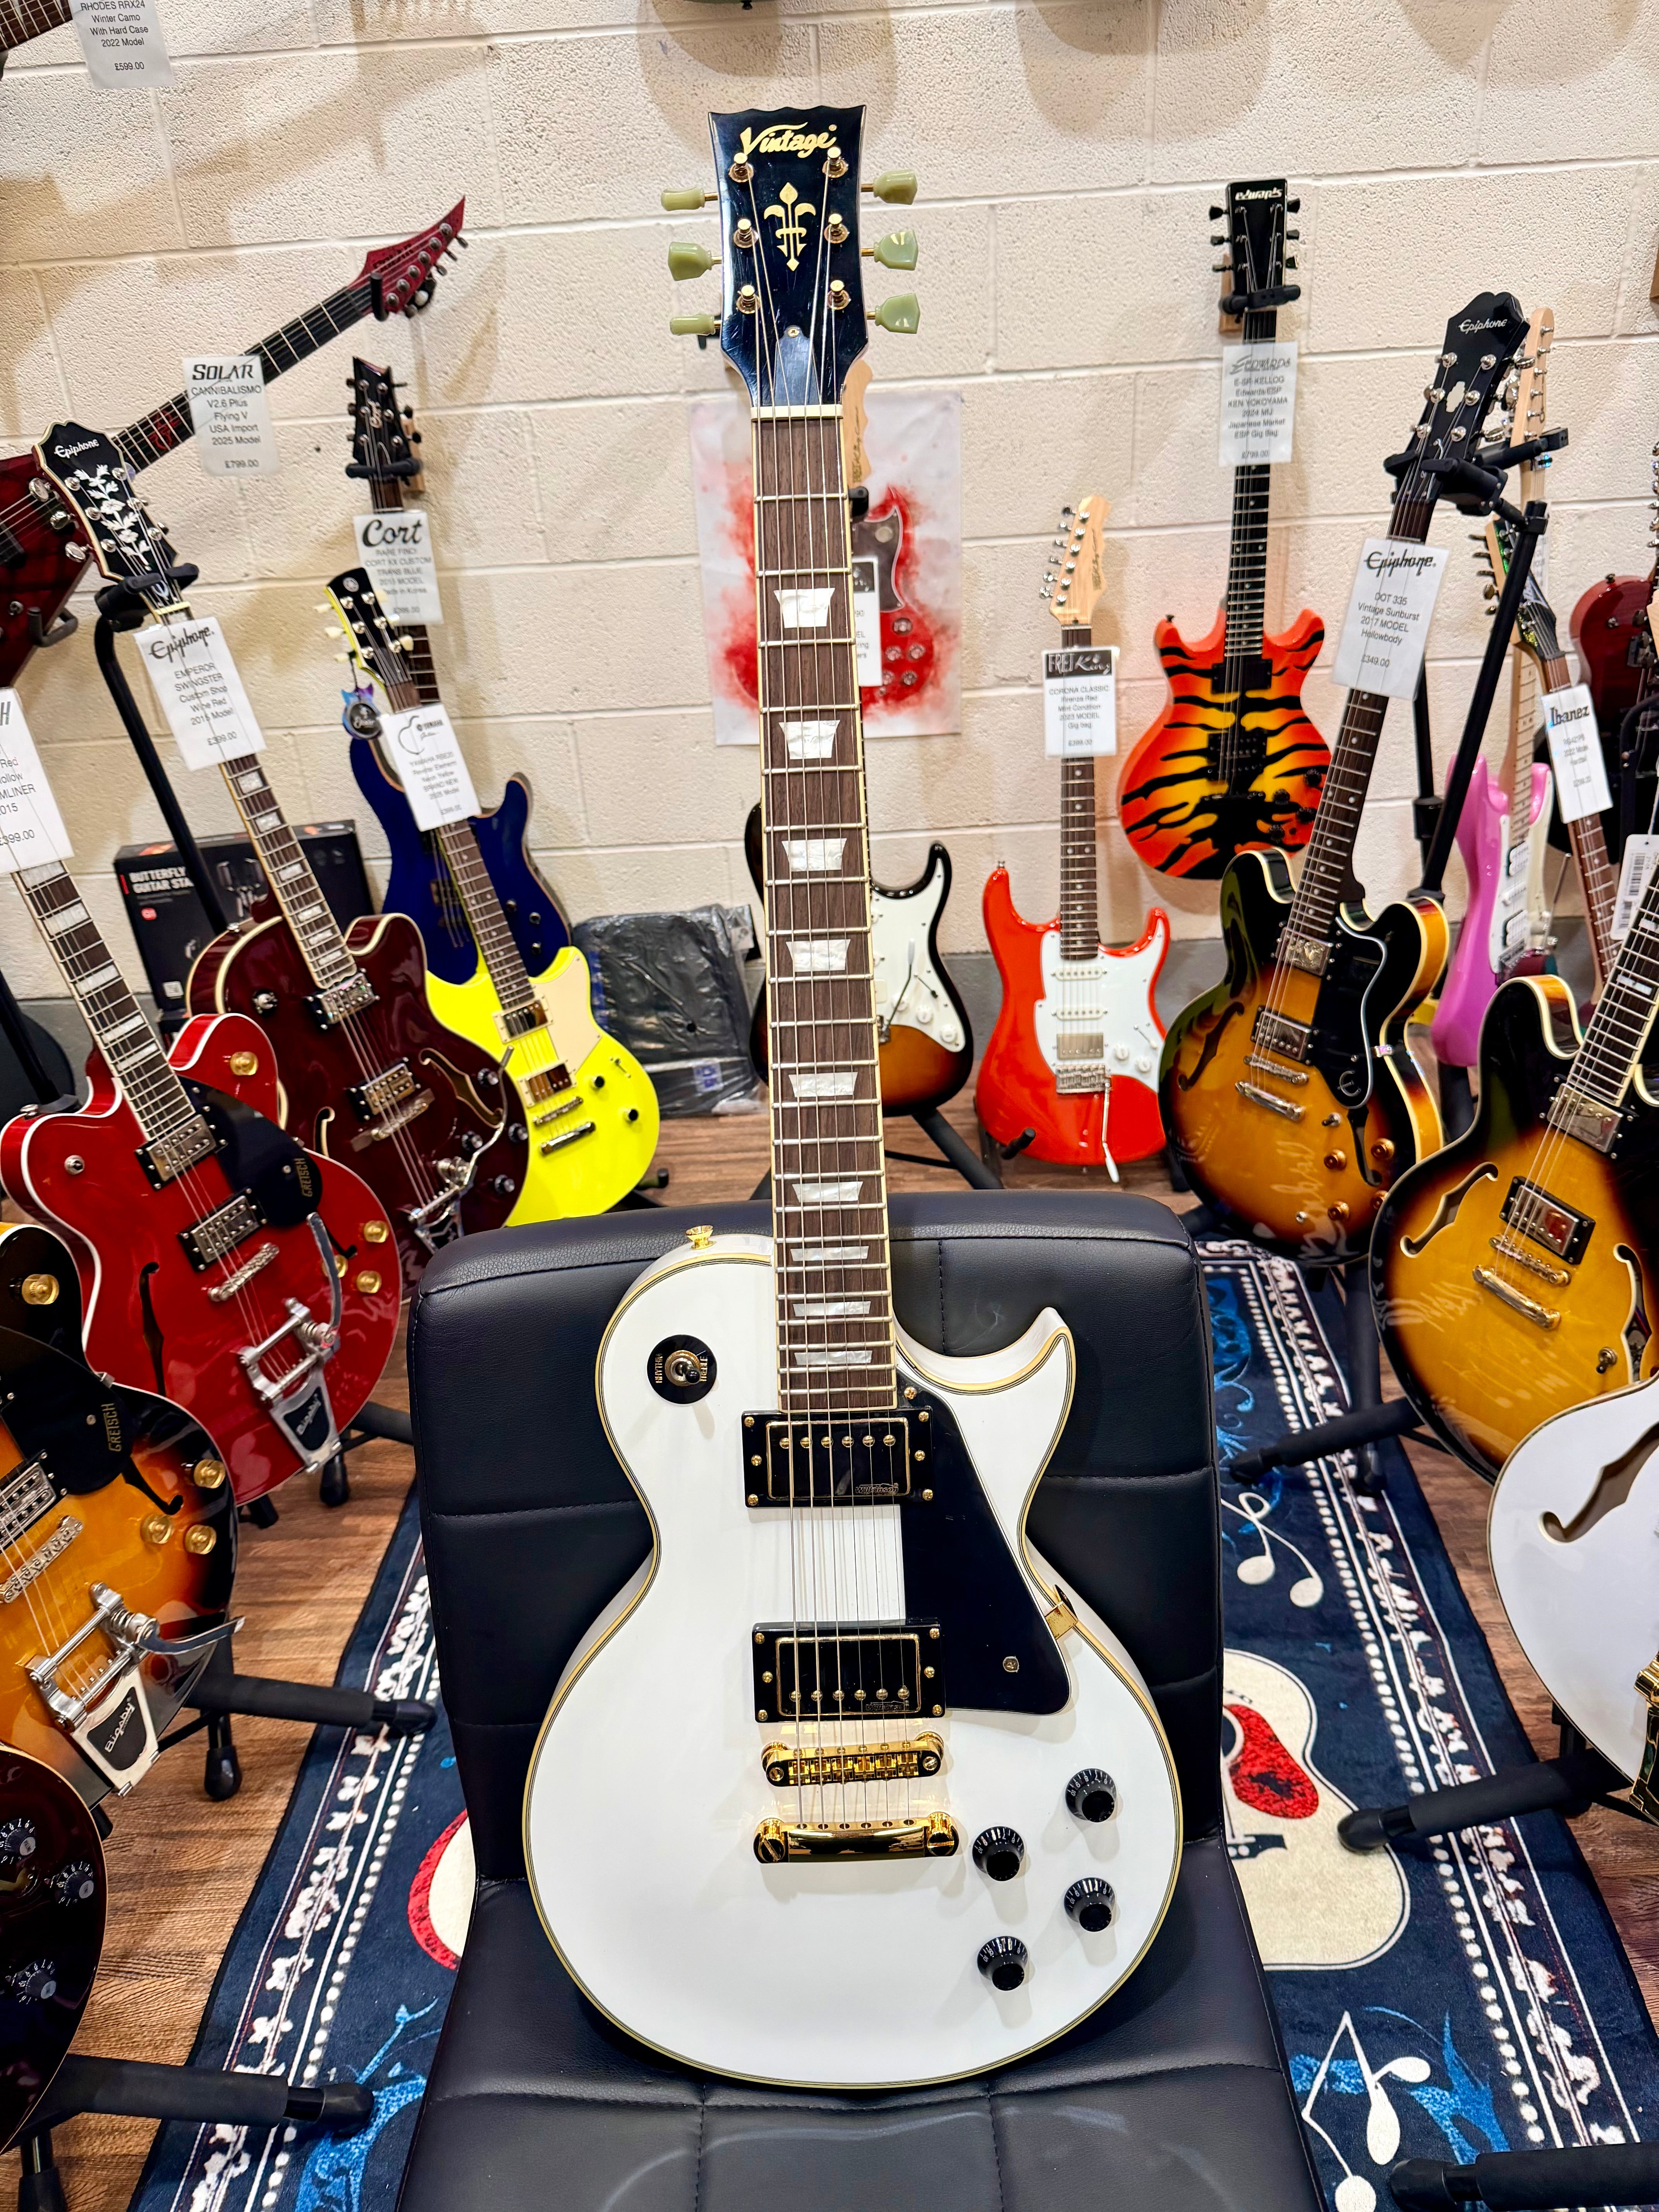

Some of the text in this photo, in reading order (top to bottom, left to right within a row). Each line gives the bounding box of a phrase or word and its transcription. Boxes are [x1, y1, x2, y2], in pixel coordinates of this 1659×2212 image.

[80, 1, 145, 11] RHODES RRX24
[92, 15, 116, 23] Winter
[90, 27, 107, 35] With
[109, 26, 127, 34] Hard
[101, 38, 144, 47] 2022 Model
[115, 62, 144, 70] £599.00
[740, 122, 837, 158] Vintage
[1458, 318, 1508, 334] Epiphone
[192, 364, 254, 380] SOLAR
[191, 385, 262, 395] CANNIBALISMO
[207, 400, 228, 408] V2.6
[214, 411, 248, 421] Flying V
[233, 424, 259, 433] Import
[235, 436, 261, 444] Model
[54, 439, 100, 459] Epiphone
[362, 519, 422, 547] Cort
[1375, 592, 1407, 606] DOT 335
[1358, 602, 1420, 621] Vintage Sunburst
[1380, 620, 1409, 633] MODEL
[1361, 629, 1403, 646] Hollowbody
[174, 662, 215, 679] EMPEROR
[175, 673, 224, 692] SWINGSTER
[1080, 685, 1109, 693] CLASSIC
[179, 689, 210, 703] Custom
[1550, 705, 1590, 726] Ibanez
[0, 757, 19, 768] Red
[0, 773, 23, 785] ollow
[129, 866, 186, 883] BUTTERFLY
[132, 880, 172, 893] GUITAR
[293, 1158, 313, 1197] GRETSCH
[101, 1403, 122, 1452] GRETSCH
[855, 1486, 899, 1494] Wilkinson
[105, 1703, 135, 1753] Bigsby
